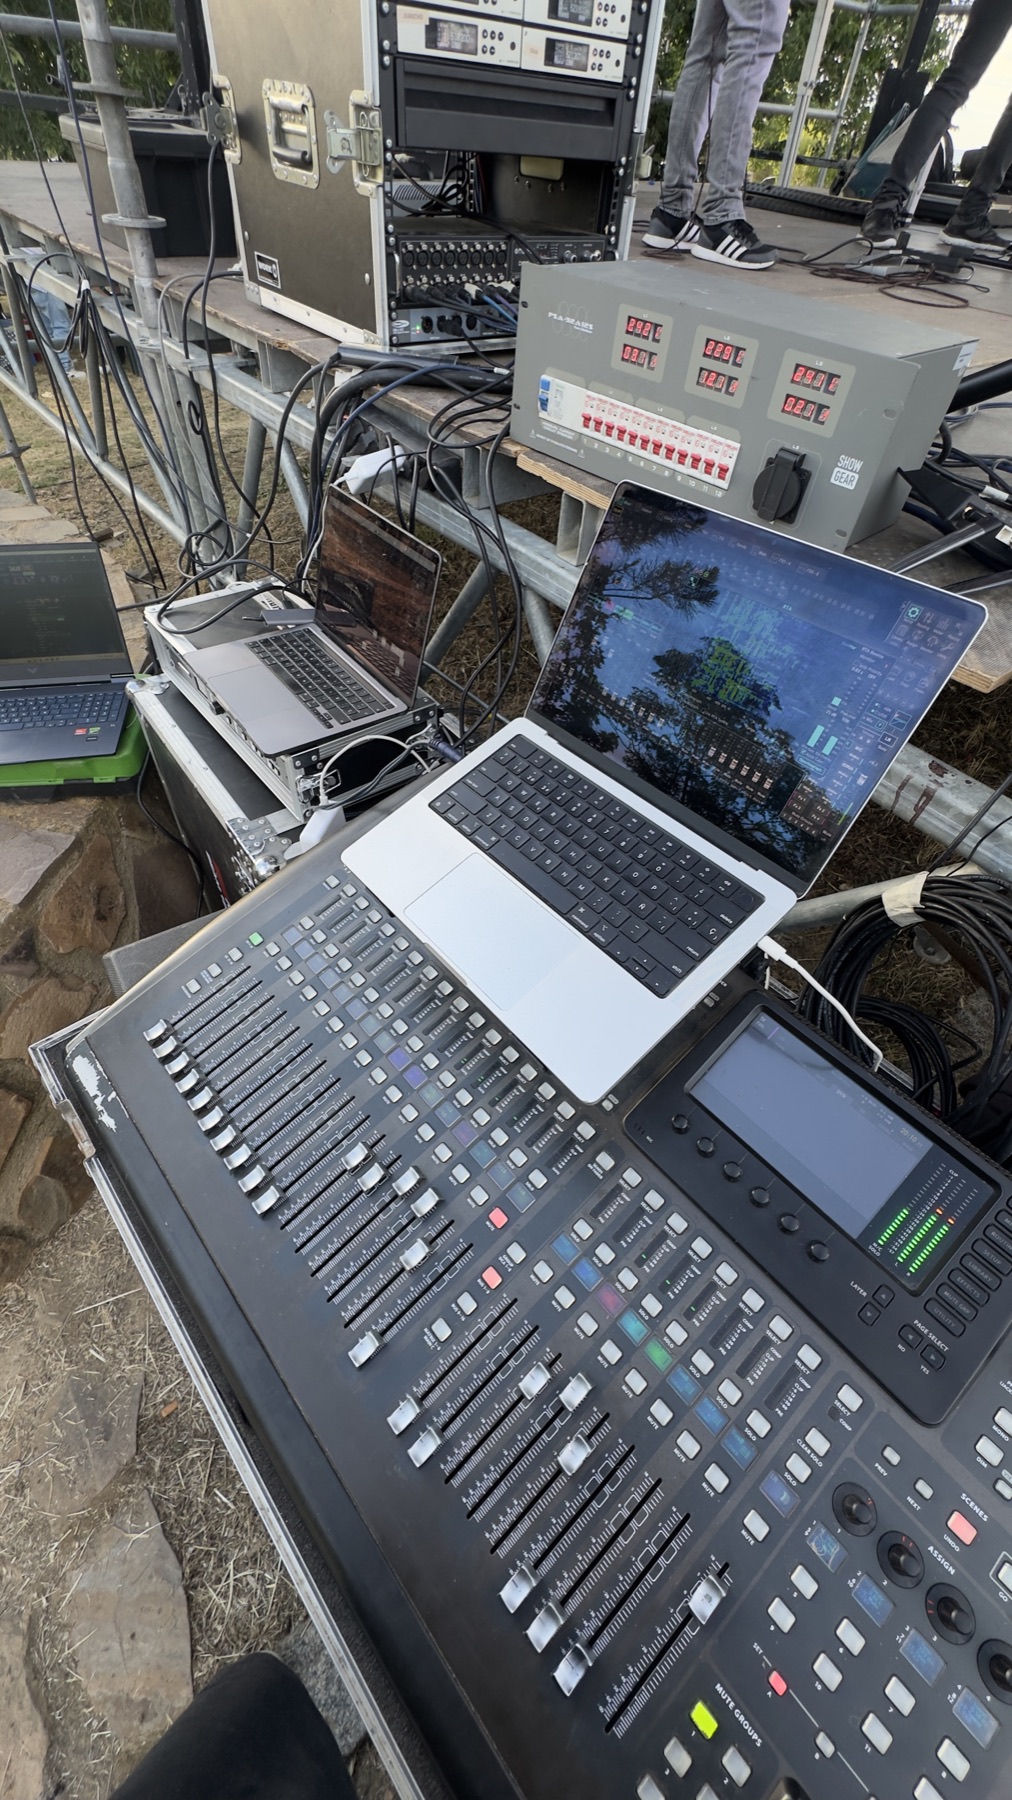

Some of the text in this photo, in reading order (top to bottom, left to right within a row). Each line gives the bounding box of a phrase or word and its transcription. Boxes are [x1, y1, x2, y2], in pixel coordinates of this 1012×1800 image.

[837, 454, 864, 472] SHOW
[833, 470, 856, 488] GEAR
[686, 946, 700, 957] return
[640, 1202, 654, 1214] SELECT
[664, 1224, 677, 1238] SELECT
[991, 1231, 1012, 1250] ROUTIN
[687, 1249, 701, 1264] SELECT
[968, 1261, 992, 1282] LIBRARY
[614, 1282, 626, 1294] SOLO
[712, 1275, 726, 1290] SELECT
[850, 1280, 868, 1298] LAYER
[956, 1276, 981, 1298] EFFECTS
[944, 1290, 958, 1306] MUTE
[638, 1308, 649, 1320] SOLO
[738, 1302, 754, 1316] SELECT
[933, 1307, 956, 1328] UTILITY
[573, 1326, 585, 1340] MUTE
[765, 1330, 782, 1346] SELECT
[913, 1319, 949, 1352] PAGE SELECT
[662, 1336, 674, 1349] SOLO
[897, 1344, 906, 1353] NO
[596, 1356, 609, 1368] MUTE
[794, 1358, 810, 1376] SELECT
[920, 1364, 930, 1375] YES
[688, 1365, 700, 1378] SOLO
[621, 1384, 634, 1398] MUTE
[716, 1396, 728, 1410] SOLO
[834, 1400, 850, 1417] SELECT
[646, 1416, 660, 1430] MUTE
[840, 1418, 852, 1431] COMP
[744, 1427, 757, 1442] SOLO
[992, 1424, 1010, 1442] MONO
[673, 1448, 686, 1464] MUTE
[796, 1438, 823, 1468] CLEAR SOLO
[874, 1462, 888, 1477] PREV
[976, 1456, 988, 1468] DIM
[784, 1471, 797, 1486] SOLO
[701, 1482, 716, 1498] MUTE
[906, 1496, 921, 1511] NEXT
[960, 1492, 989, 1522] SCENES
[740, 1529, 755, 1546] MUTE
[943, 1534, 960, 1552] UNDO
[928, 1545, 956, 1576] ASSIGN
[998, 1591, 1008, 1602] GO
[752, 1642, 764, 1654] SET
[714, 1682, 763, 1748] MUTE GROUPS
